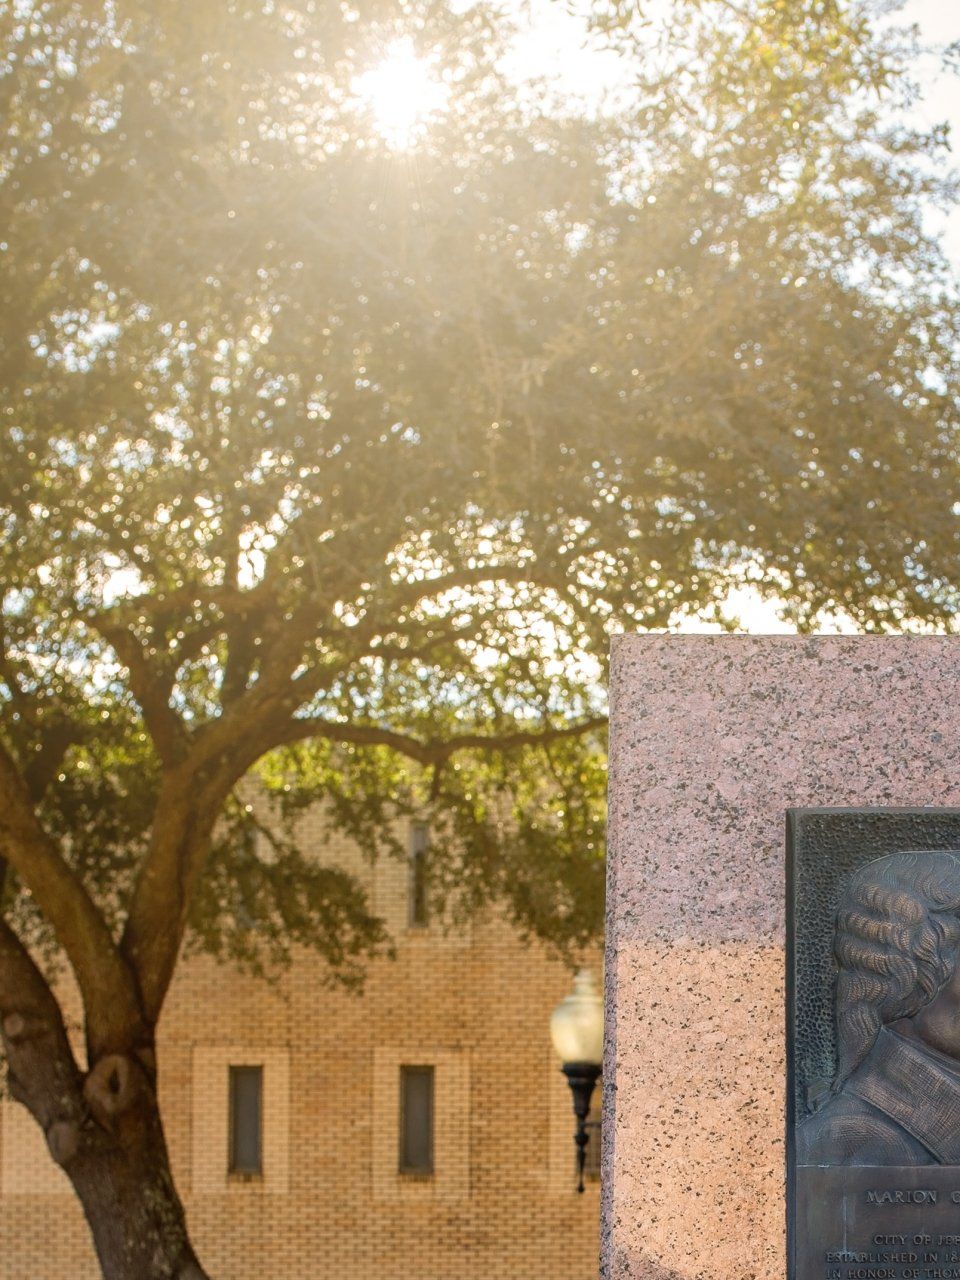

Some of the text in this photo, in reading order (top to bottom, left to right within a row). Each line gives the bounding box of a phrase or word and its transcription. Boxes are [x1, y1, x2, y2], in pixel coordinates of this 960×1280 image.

[866, 1191, 937, 1204] MARION
[873, 1235, 906, 1247] CITY
[912, 1235, 932, 1247] OF
[826, 1251, 918, 1263] ESTABLISHED
[923, 1251, 939, 1263] IN
[826, 1268, 842, 1280] IN
[847, 1268, 896, 1280] HONOR
[902, 1268, 920, 1280] OF
